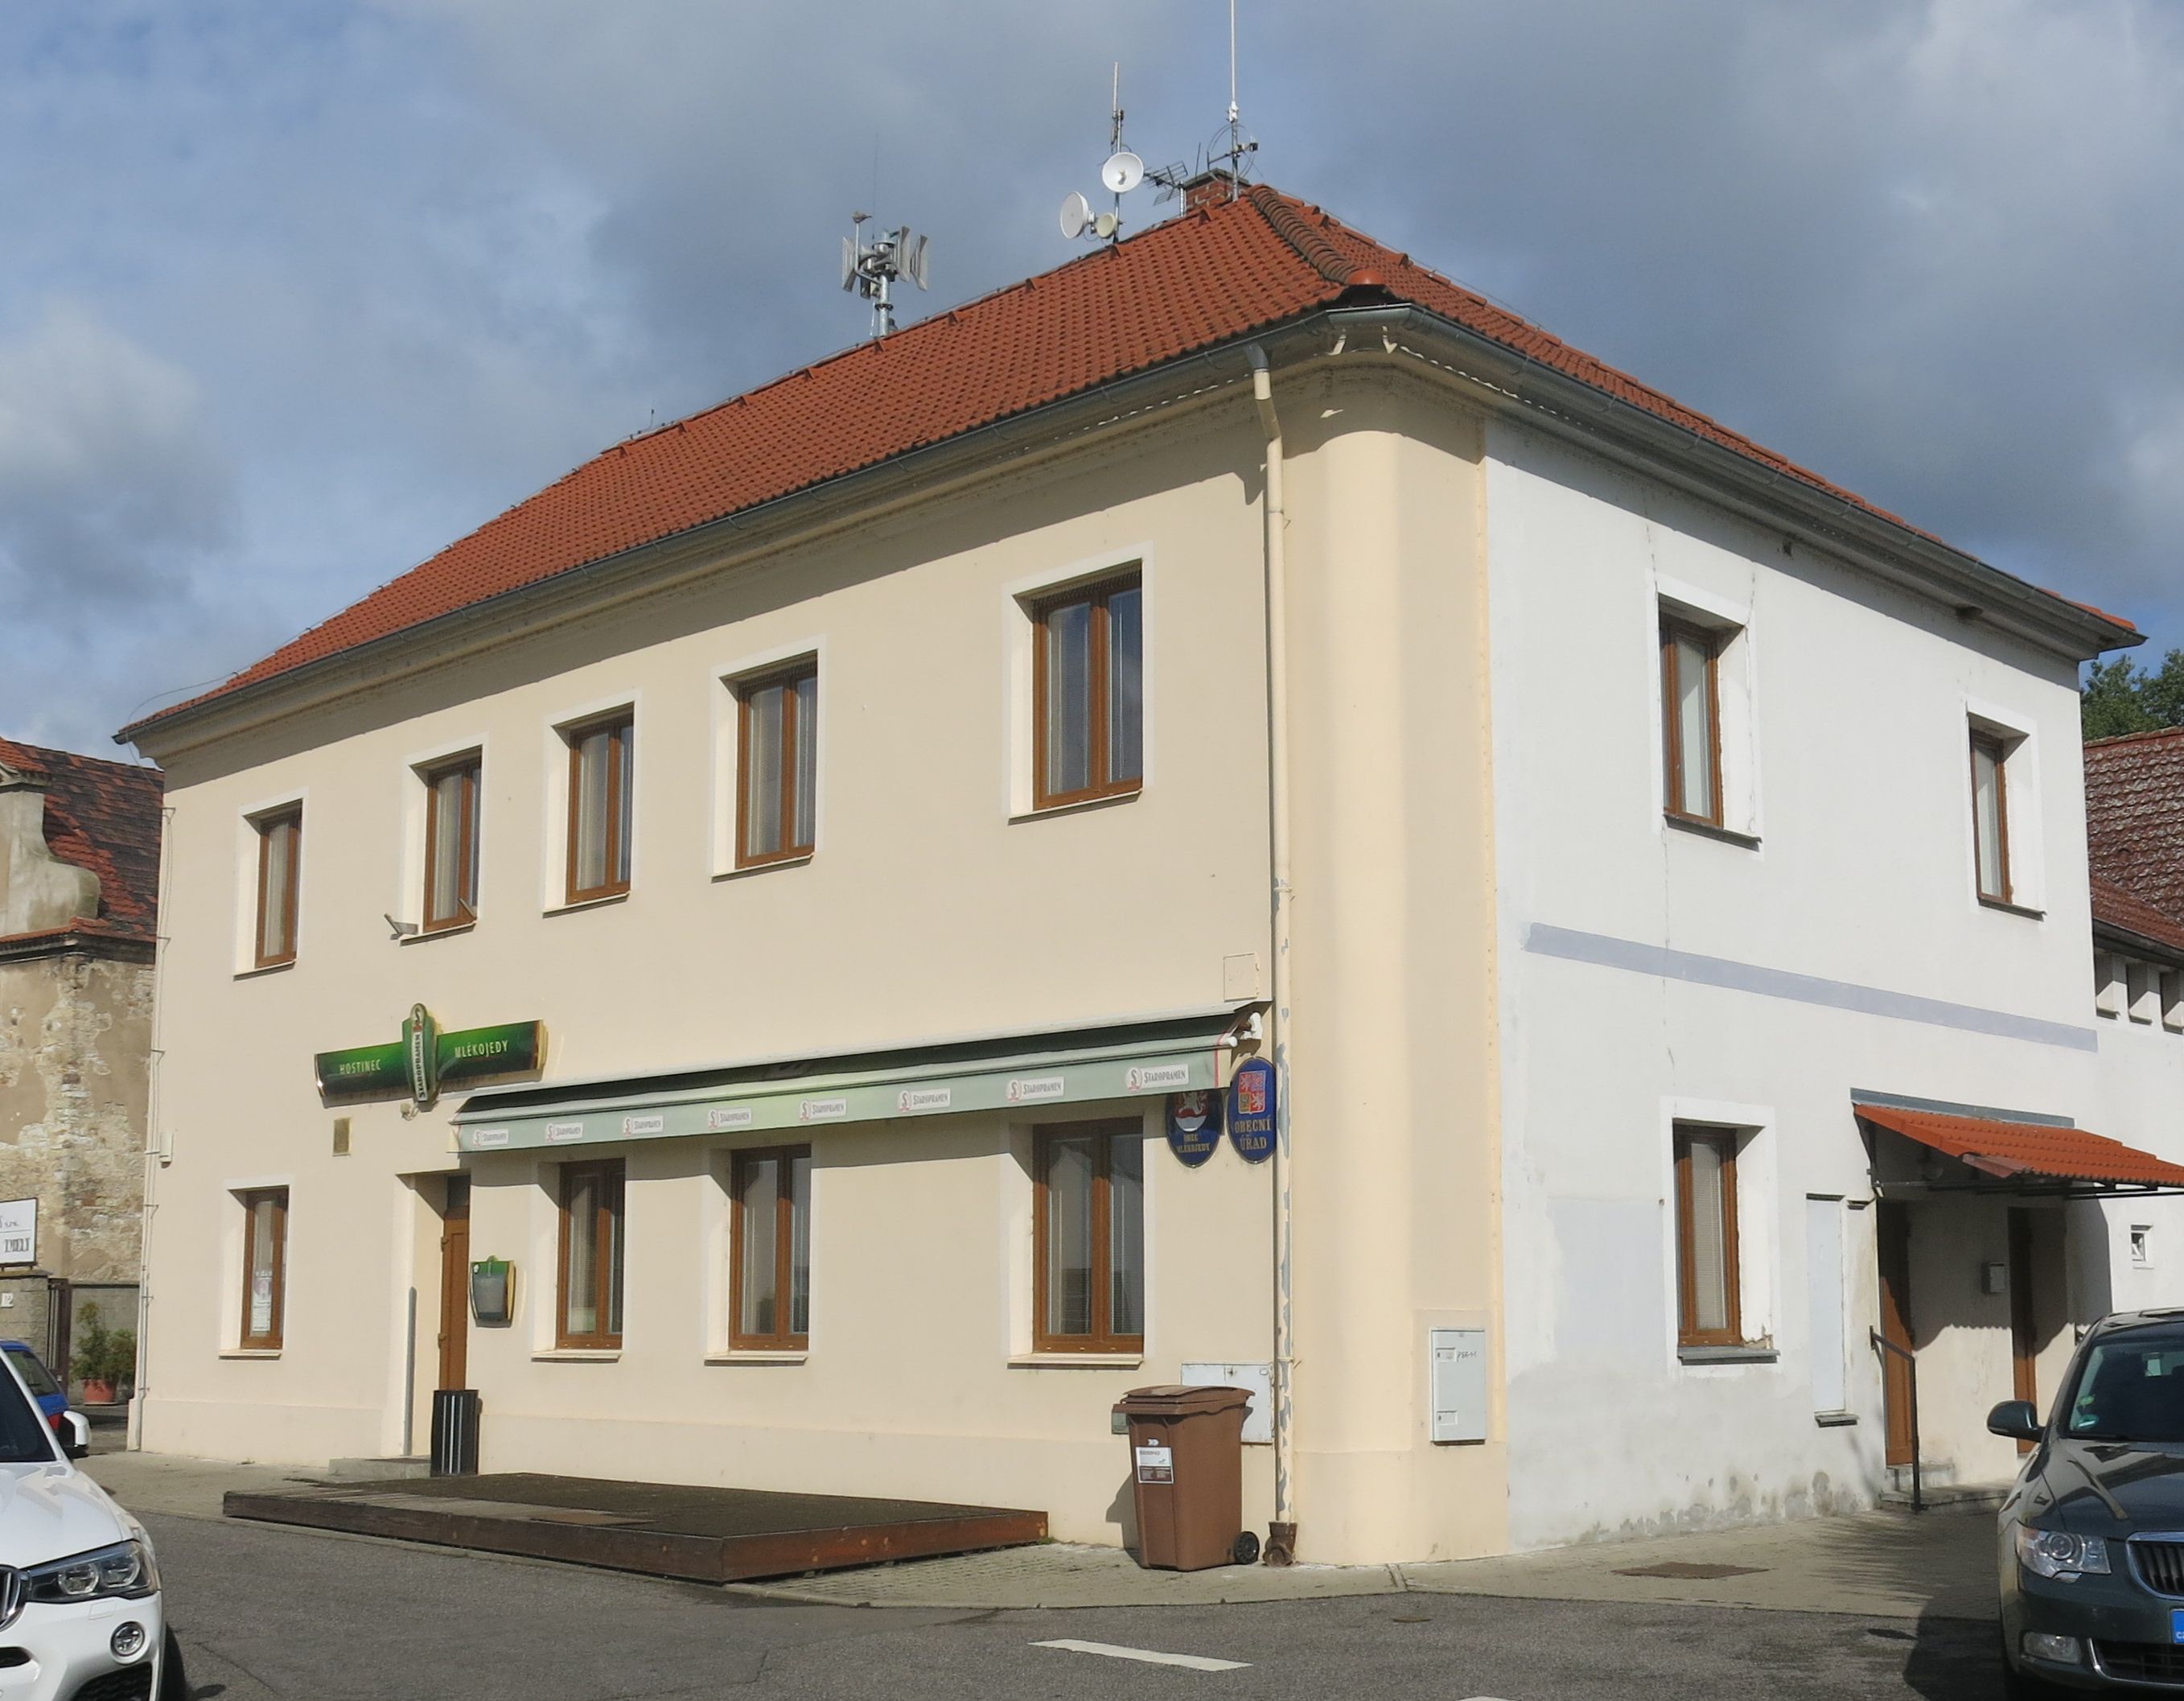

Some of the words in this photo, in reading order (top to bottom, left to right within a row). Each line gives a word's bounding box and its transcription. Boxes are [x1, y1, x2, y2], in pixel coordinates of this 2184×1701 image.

[454, 1040, 509, 1058] MLÉKOJEDY
[339, 1059, 381, 1075] HOSTINEC
[1235, 1115, 1271, 1133] OBECNÍ
[1240, 1134, 1267, 1151] ÚŘAD
